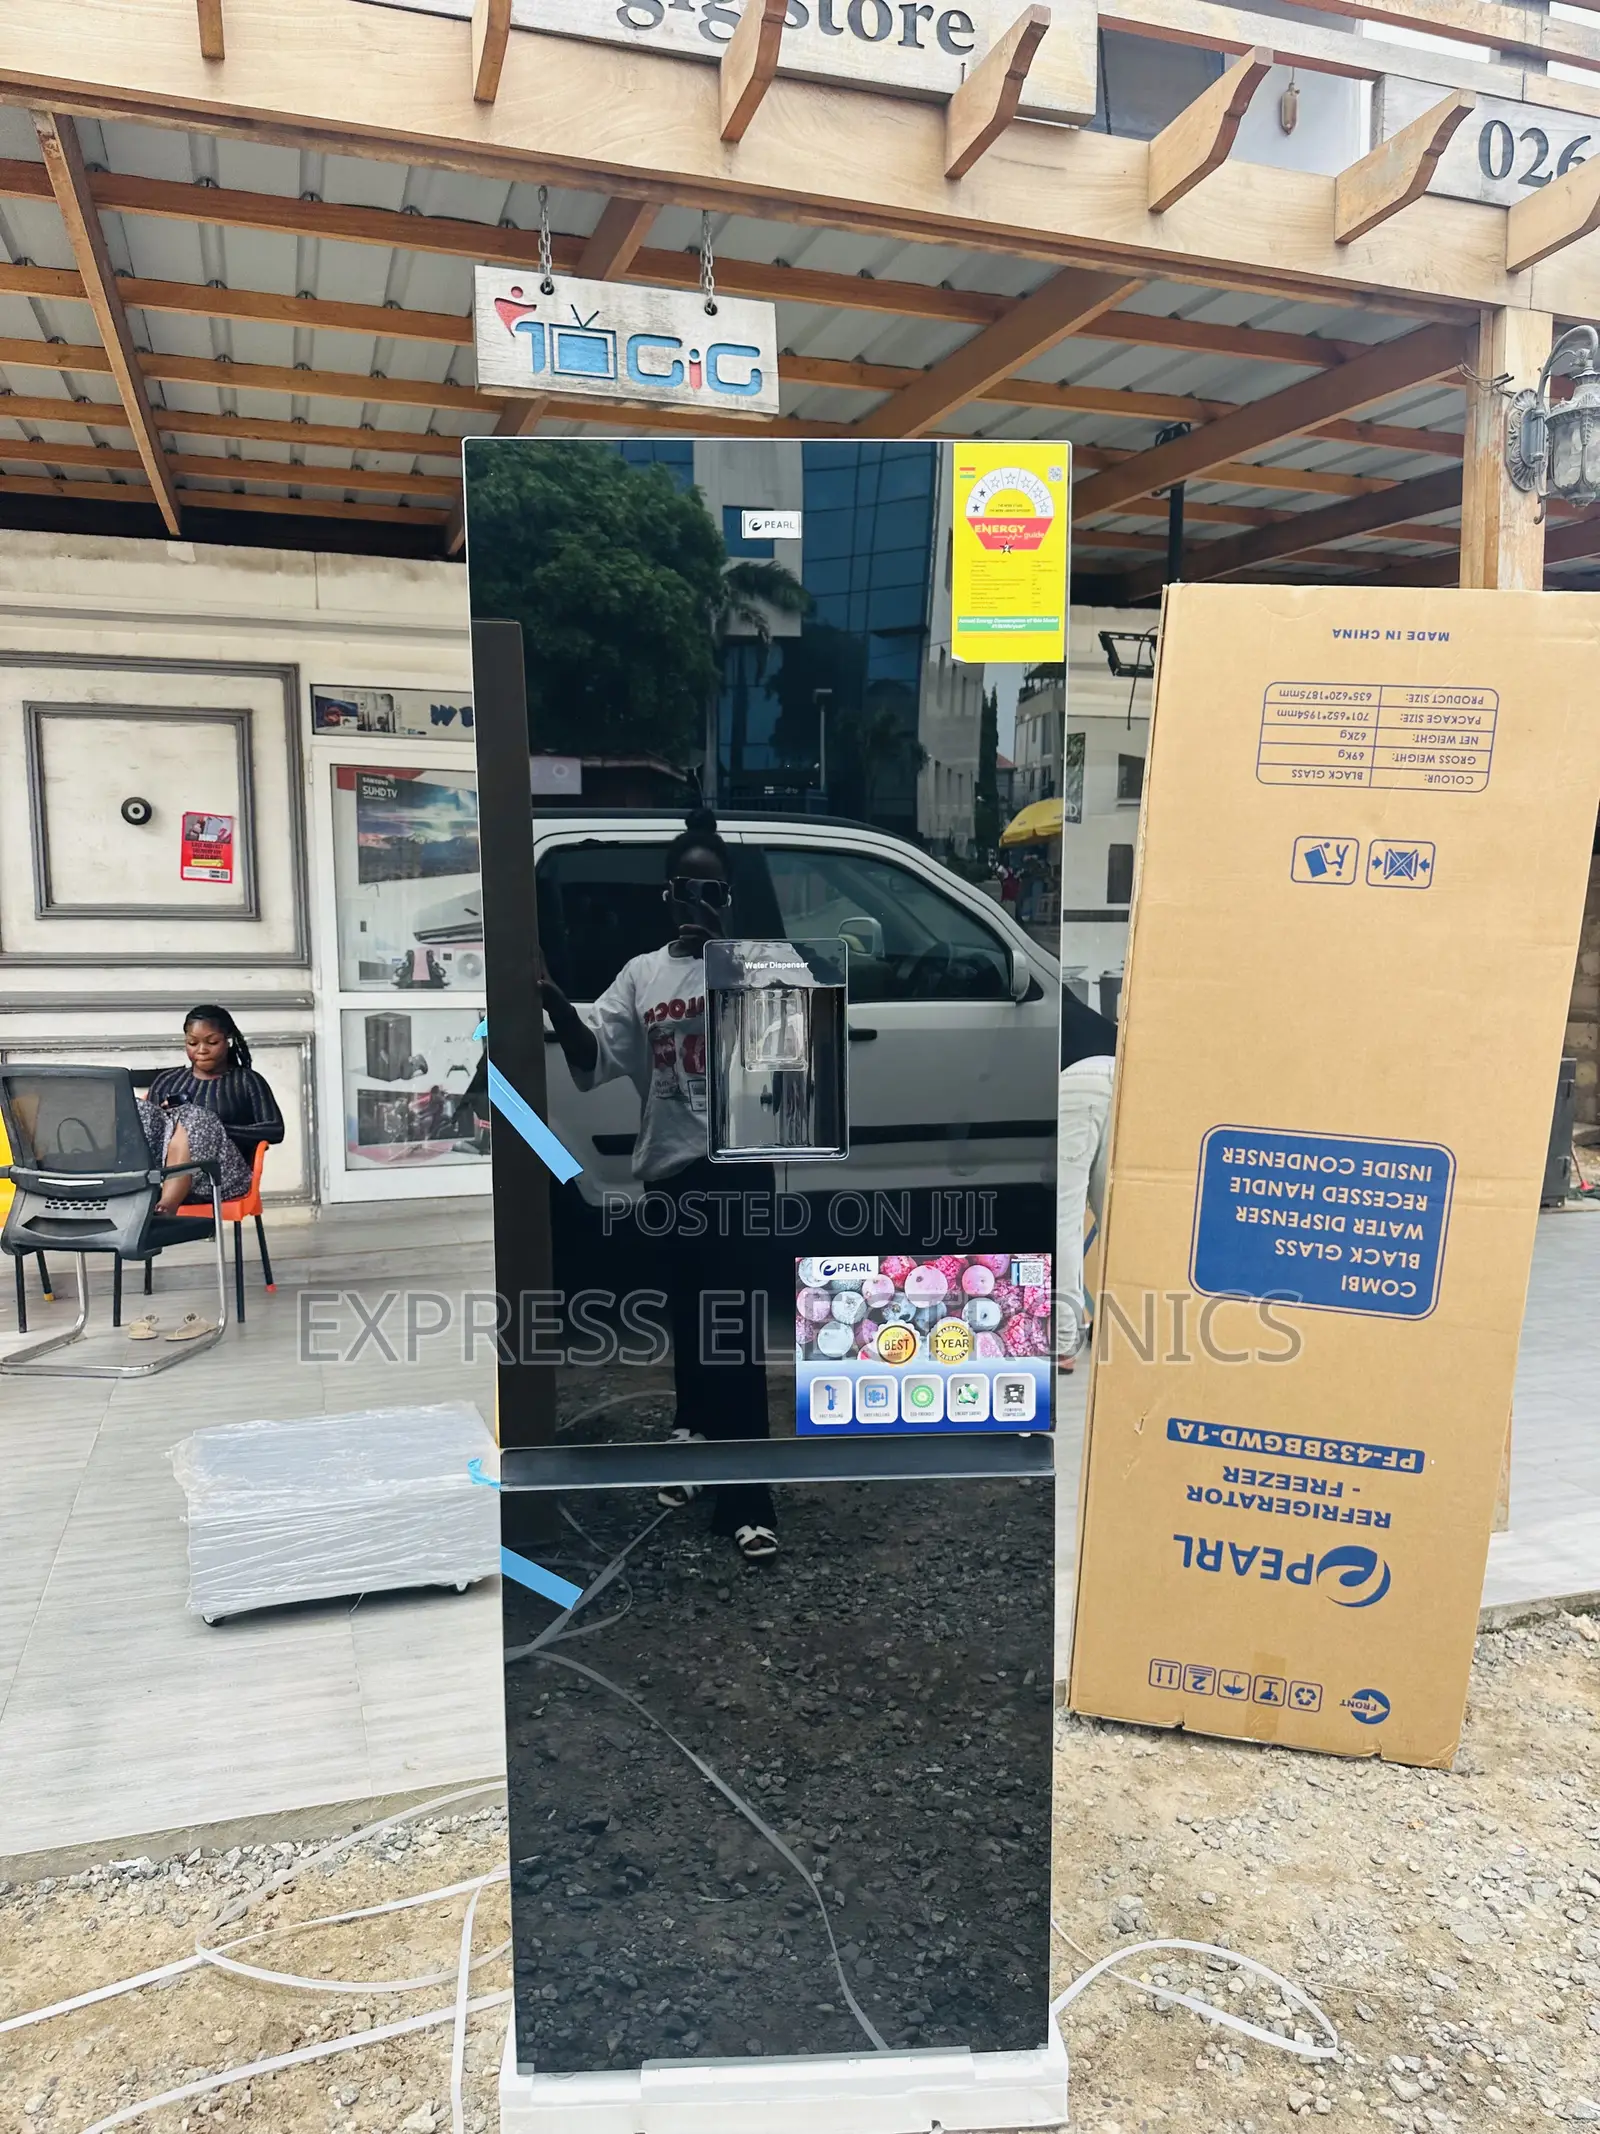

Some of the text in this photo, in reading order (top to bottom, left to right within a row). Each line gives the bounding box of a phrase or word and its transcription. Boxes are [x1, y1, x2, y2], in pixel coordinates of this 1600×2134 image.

[764, 520, 795, 529] PEARL
[974, 523, 1026, 535] ENERGY
[1023, 531, 1045, 540] guide
[1332, 628, 1450, 642] MADE IN CHINA
[1405, 693, 1484, 706] PRODUCT SIZE:
[1400, 713, 1482, 726] PACKAGE SIZE:
[1339, 729, 1367, 741] 62Kg
[1412, 733, 1479, 746] NET WEIGHT:
[1337, 749, 1365, 761] 69Kg
[1392, 752, 1477, 766] GROSS WEIGHT:
[1291, 769, 1364, 781] BLACK GLASS
[1424, 774, 1474, 785] COLOUR:
[362, 786, 398, 799] SUHD TV
[744, 961, 809, 970] Water Dispenser
[1222, 1147, 1433, 1182] INSIDE CONDENSER
[1229, 1176, 1428, 1212] RECESSED HANDLE
[1235, 1205, 1424, 1241] WATER DISPENSER
[1274, 1238, 1420, 1270] BLACK GLASS
[837, 1259, 872, 1272] PEARL
[1340, 1275, 1417, 1298] COMBI
[884, 1339, 909, 1351] BEST
[941, 1339, 969, 1348] YEAR
[1176, 1421, 1417, 1471] PF-433BBGWD-1A
[1222, 1465, 1344, 1498] FREEZER
[1186, 1484, 1392, 1529] REFRIGERATOR
[1173, 1533, 1316, 1586] PEARL
[1191, 1674, 1206, 1691] 2
[1339, 1699, 1377, 1711] FRONT
